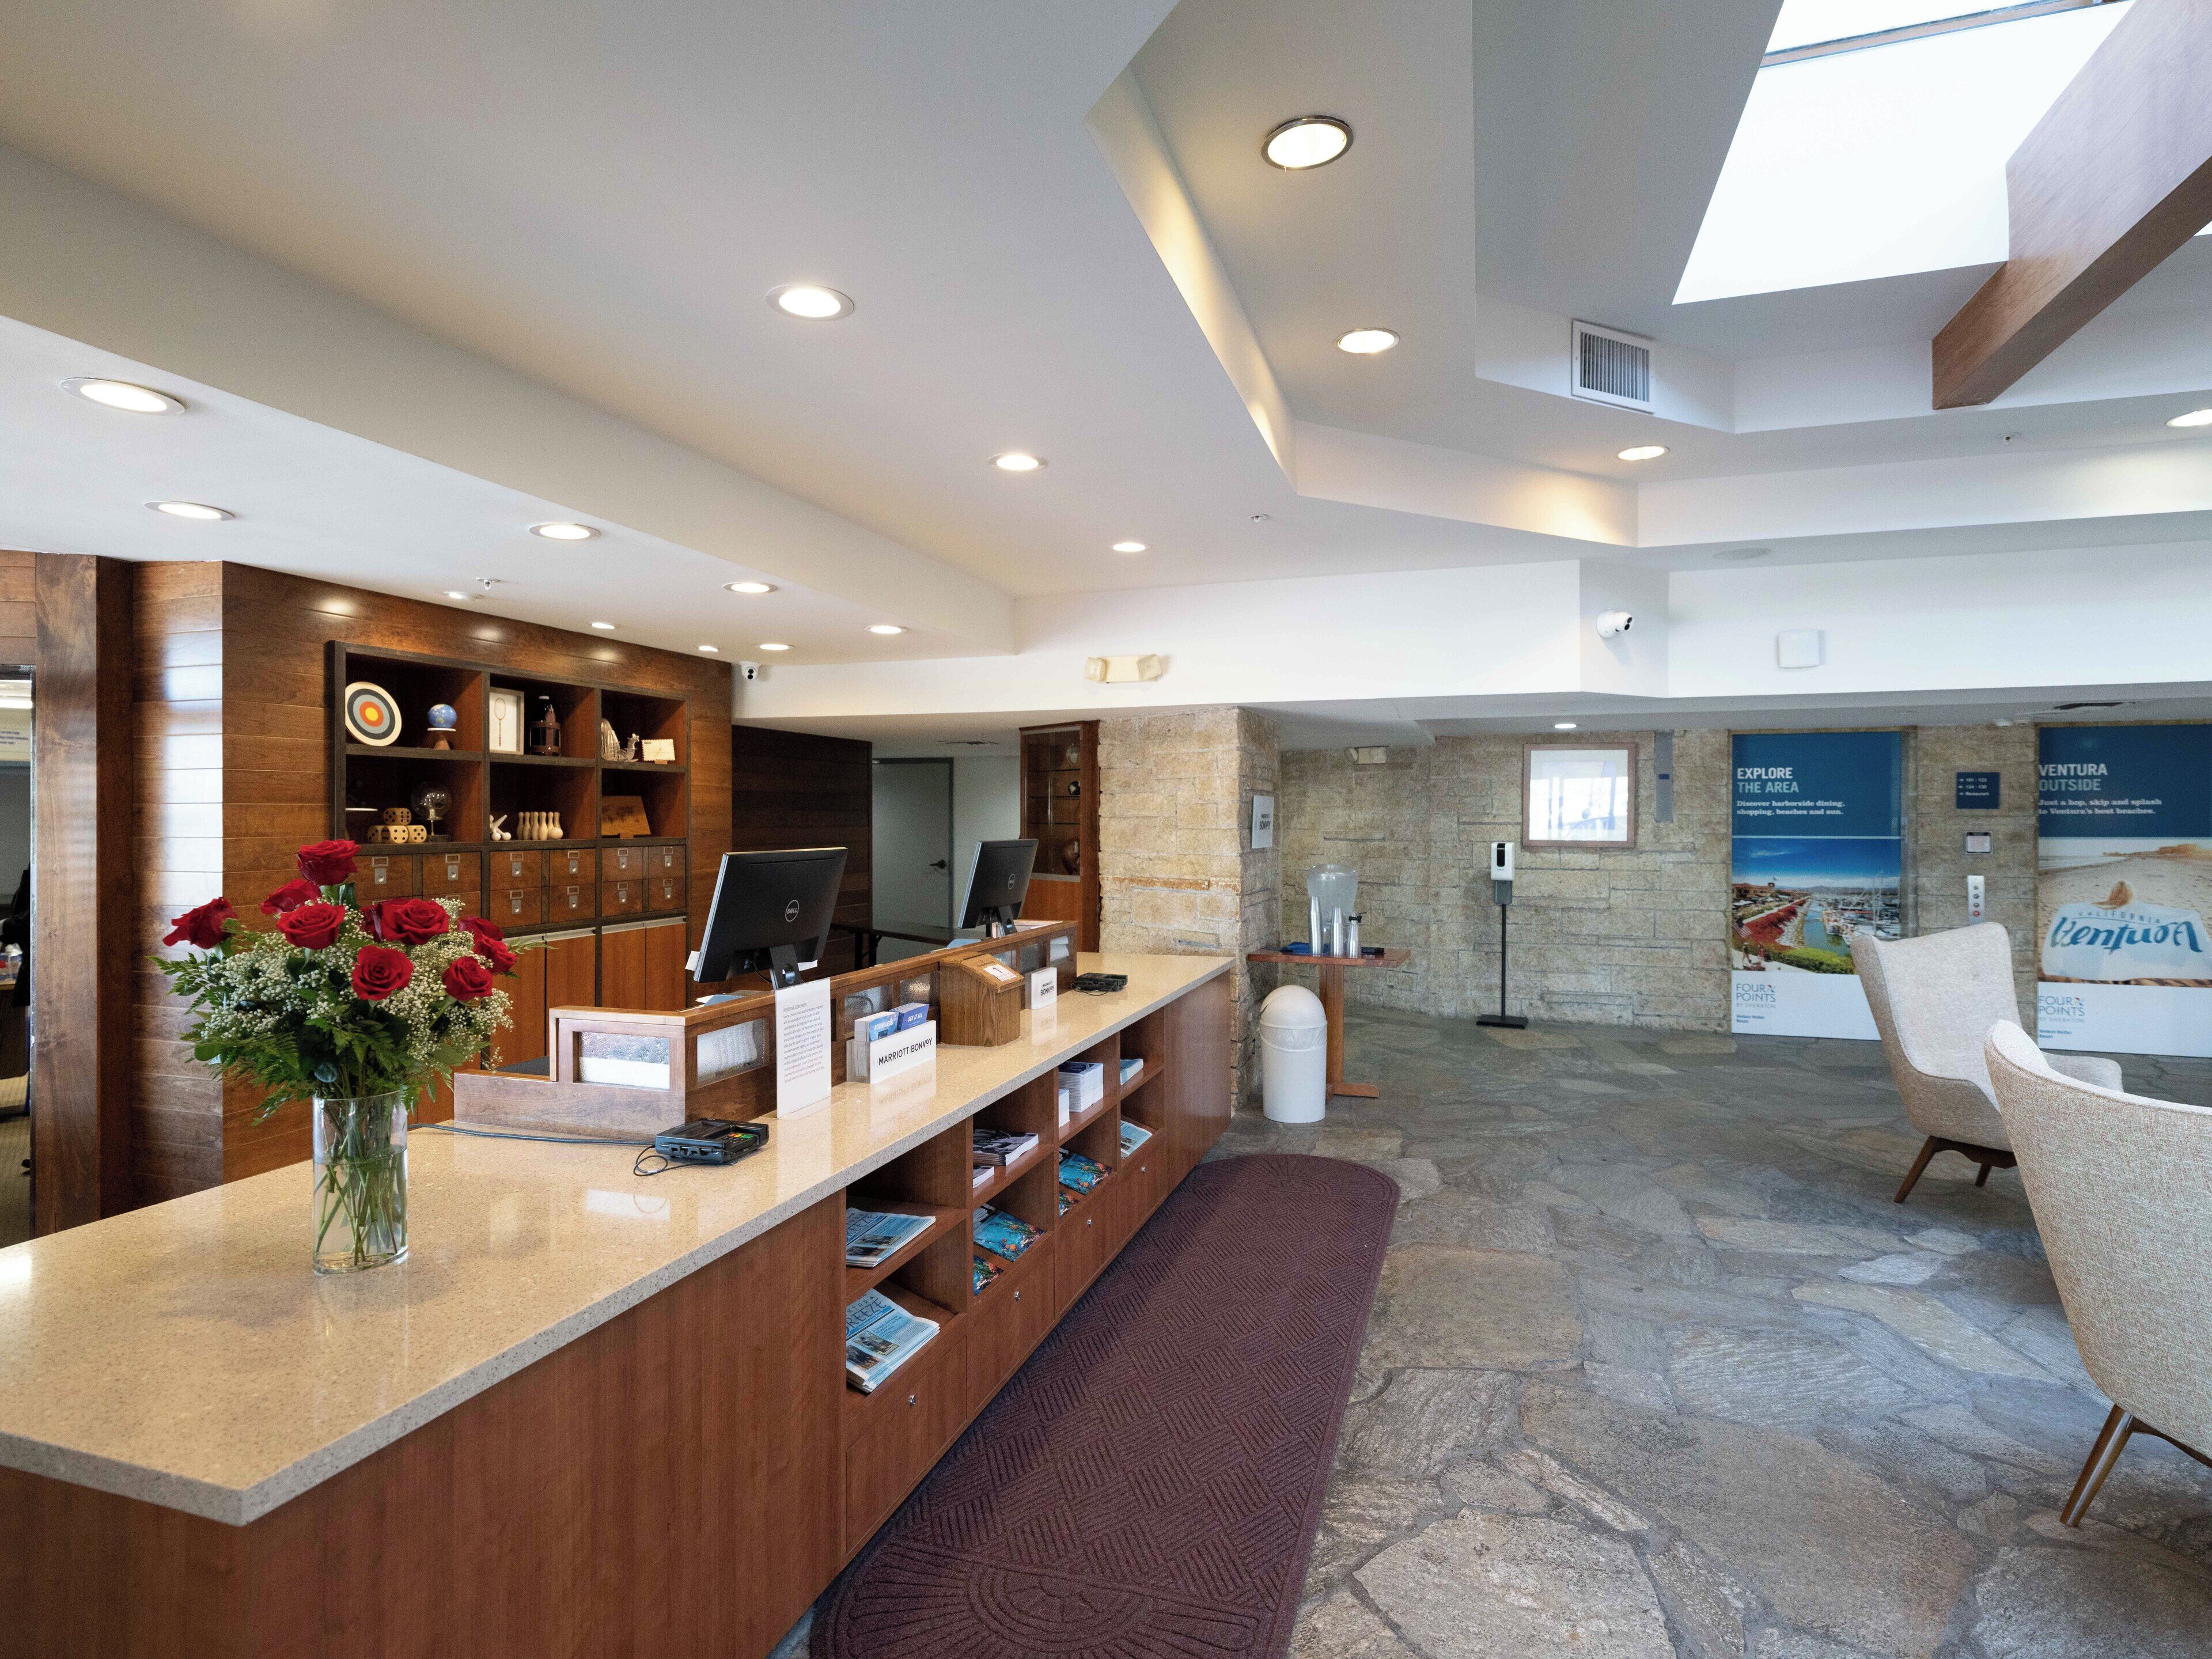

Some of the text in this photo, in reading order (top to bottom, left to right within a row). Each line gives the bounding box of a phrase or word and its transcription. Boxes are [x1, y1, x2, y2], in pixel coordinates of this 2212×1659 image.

[1737, 767, 1793, 779] EXPLORE
[2039, 763, 2108, 776] VENTURA
[1737, 782, 1800, 793] THE AREA
[2039, 779, 2101, 791] OUTSIDE
[2131, 798, 2162, 806] splash
[2078, 910, 2161, 923] CALIFORNIA
[1736, 983, 1766, 993] FOUR
[1736, 993, 1776, 1002] POINTS
[2039, 995, 2074, 1006] FOUR
[2039, 1006, 2085, 1017] POINTS
[878, 1037, 933, 1066] MARRIOTT BONVOY
